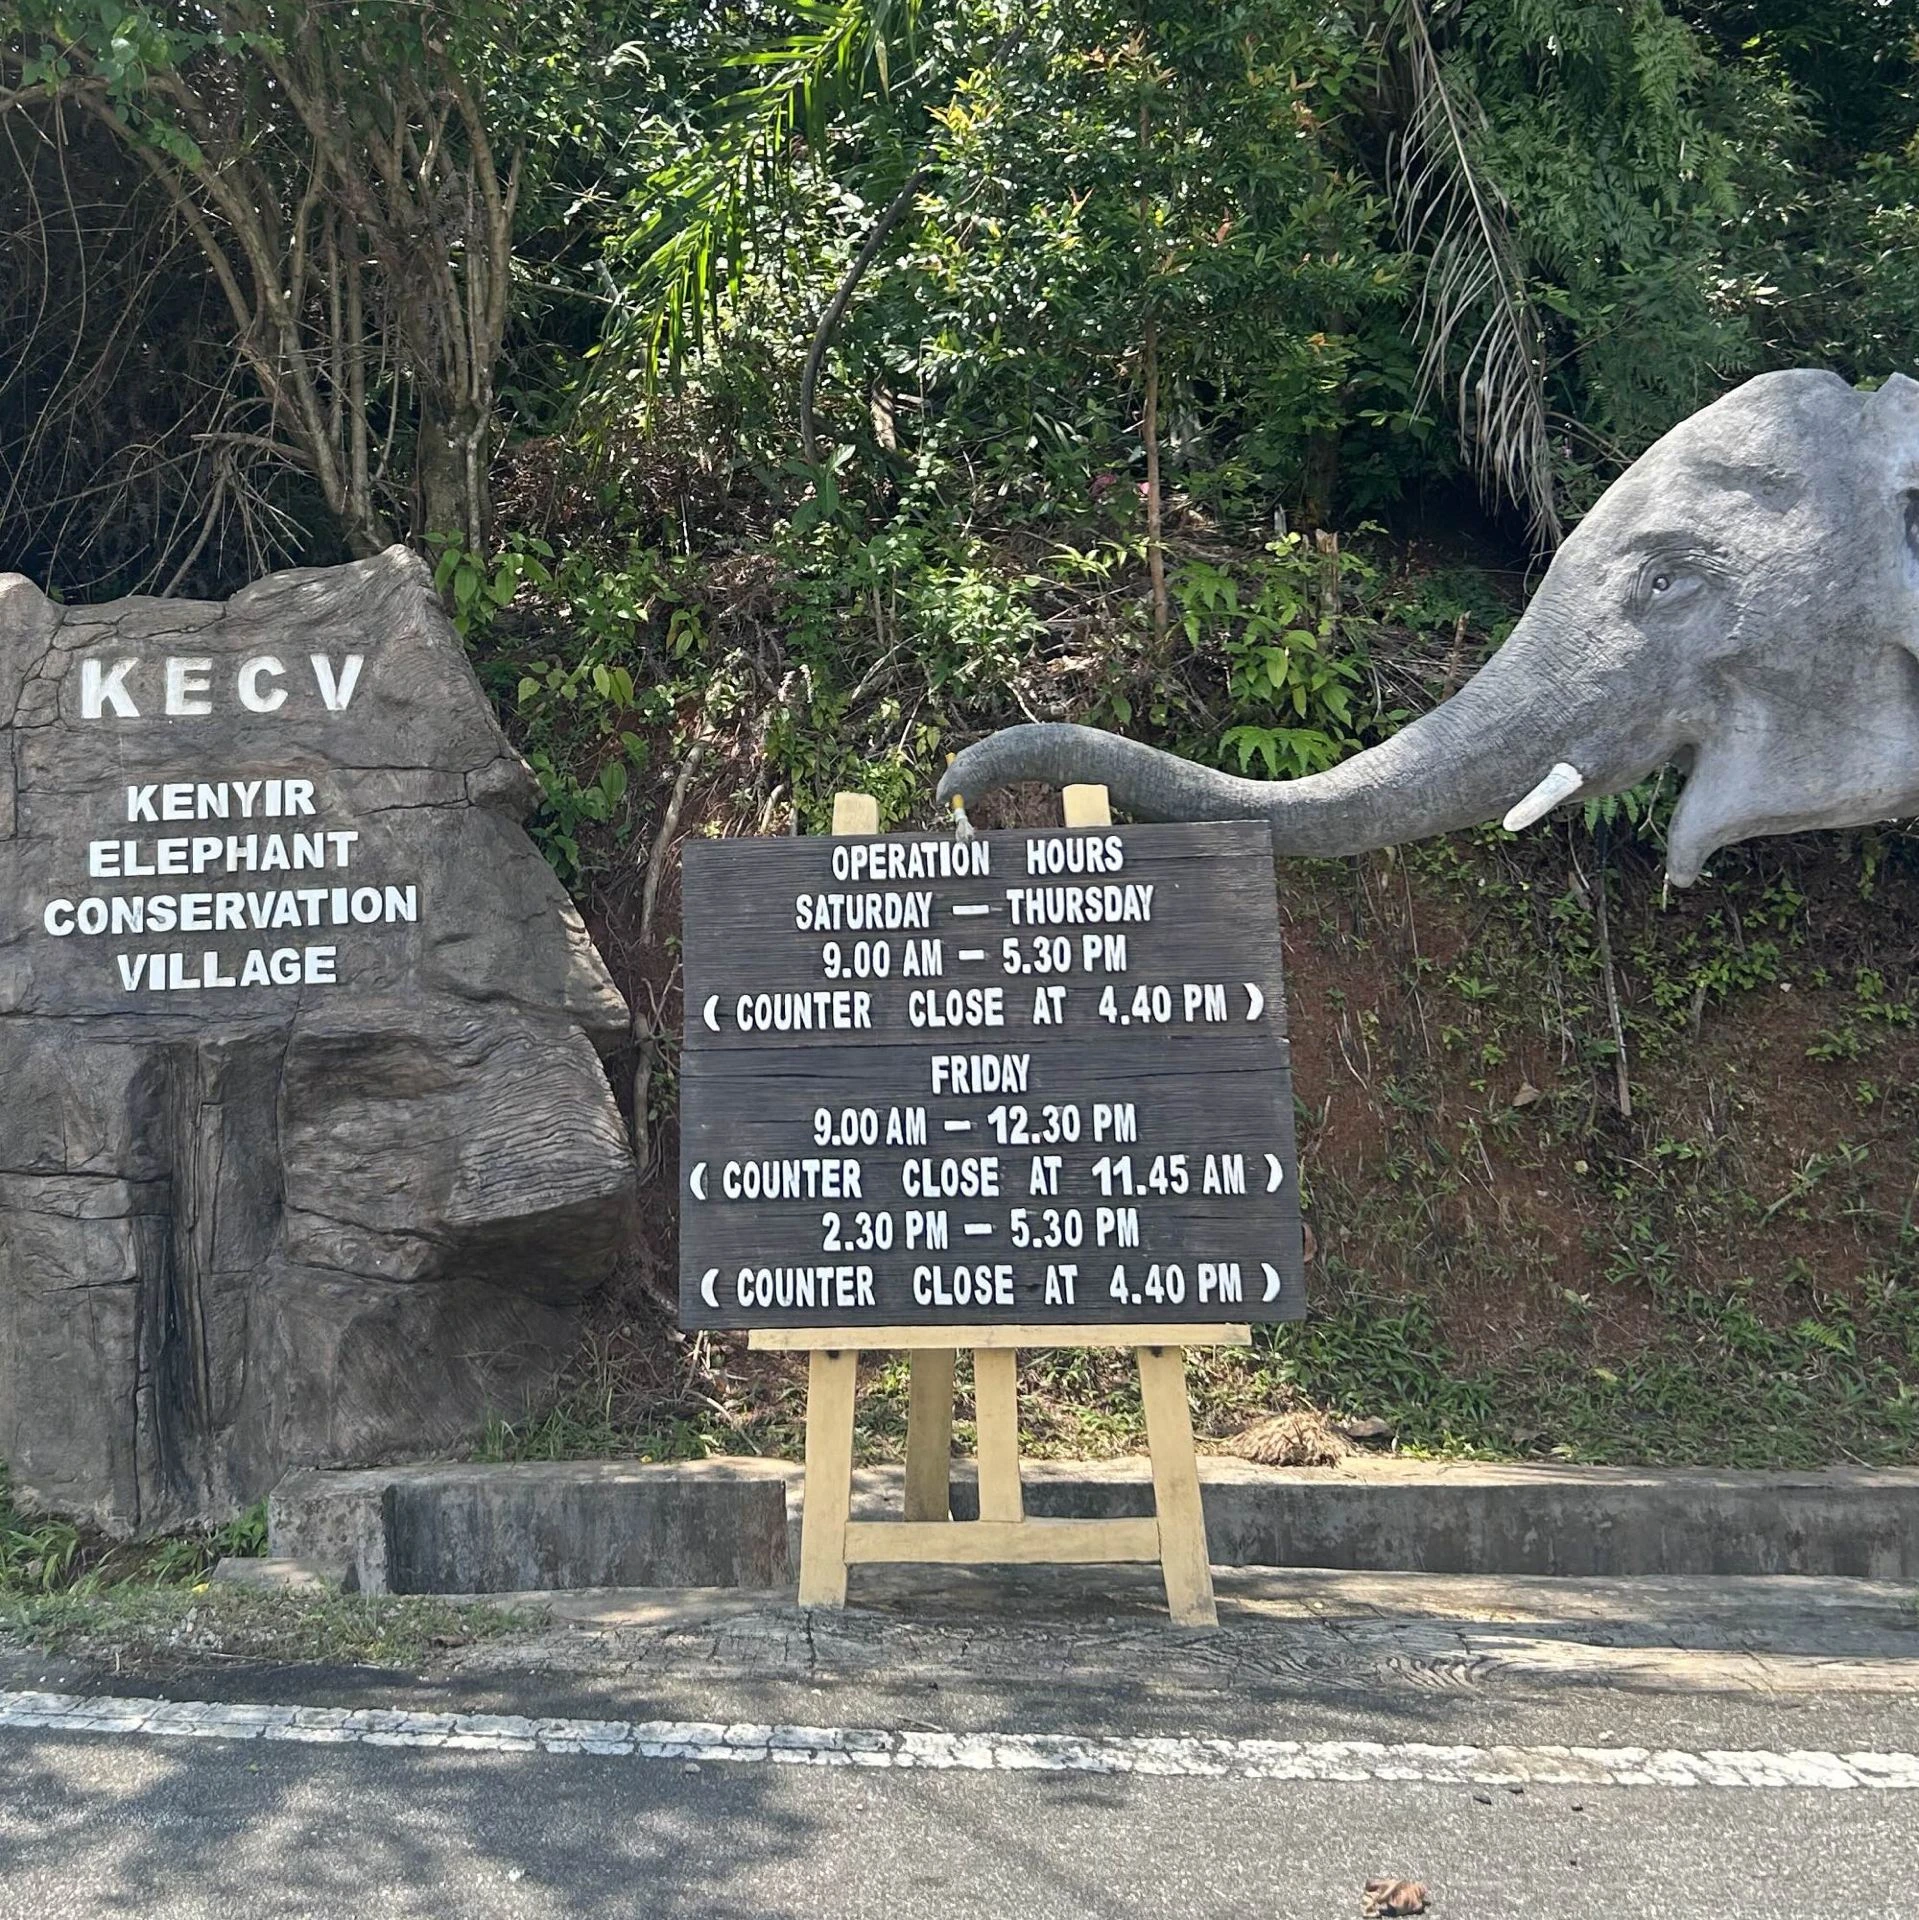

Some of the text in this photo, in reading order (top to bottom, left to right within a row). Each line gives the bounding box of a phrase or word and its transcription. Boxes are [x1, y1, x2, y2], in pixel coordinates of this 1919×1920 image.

[79, 652, 365, 720] KECV
[124, 779, 317, 822] KENYIR
[88, 830, 359, 878] ELEPHANT
[832, 835, 1124, 881] OPERATION HOURS
[43, 885, 417, 937] CONSERVATION
[795, 891, 933, 931] SATURDAY
[1006, 884, 1154, 925] THURSDAY
[116, 945, 337, 991] VILLAGE
[822, 940, 891, 979] 9.00
[902, 938, 943, 977] AM
[1002, 935, 1072, 974] 5.30
[1082, 934, 1127, 972] PM
[736, 990, 872, 1032] COUNTER
[908, 987, 1005, 1028] CLOSE
[1033, 985, 1067, 1025] AT
[1098, 984, 1172, 1026] 4.40
[1183, 983, 1228, 1022] PM
[931, 1053, 1030, 1094] FRIDAY
[813, 1107, 879, 1146] 9.00
[886, 1106, 927, 1146] AM
[987, 1104, 1081, 1145] 12.30
[1093, 1103, 1137, 1143] PM
[722, 1158, 863, 1199] COUNTER
[902, 1156, 1000, 1198] CLOSE
[1029, 1155, 1063, 1196] AT
[1091, 1154, 1189, 1196] 11.45
[1202, 1153, 1246, 1195] AM
[822, 1211, 893, 1252] 2.30
[905, 1210, 948, 1250] PM
[1010, 1207, 1083, 1248] 5.30
[1096, 1207, 1140, 1248] PM
[737, 1265, 876, 1308] COUNTER
[913, 1264, 1014, 1306] CLOSE
[1044, 1264, 1078, 1305] AT
[1109, 1264, 1186, 1305] 4.40
[1197, 1262, 1243, 1303] PM
